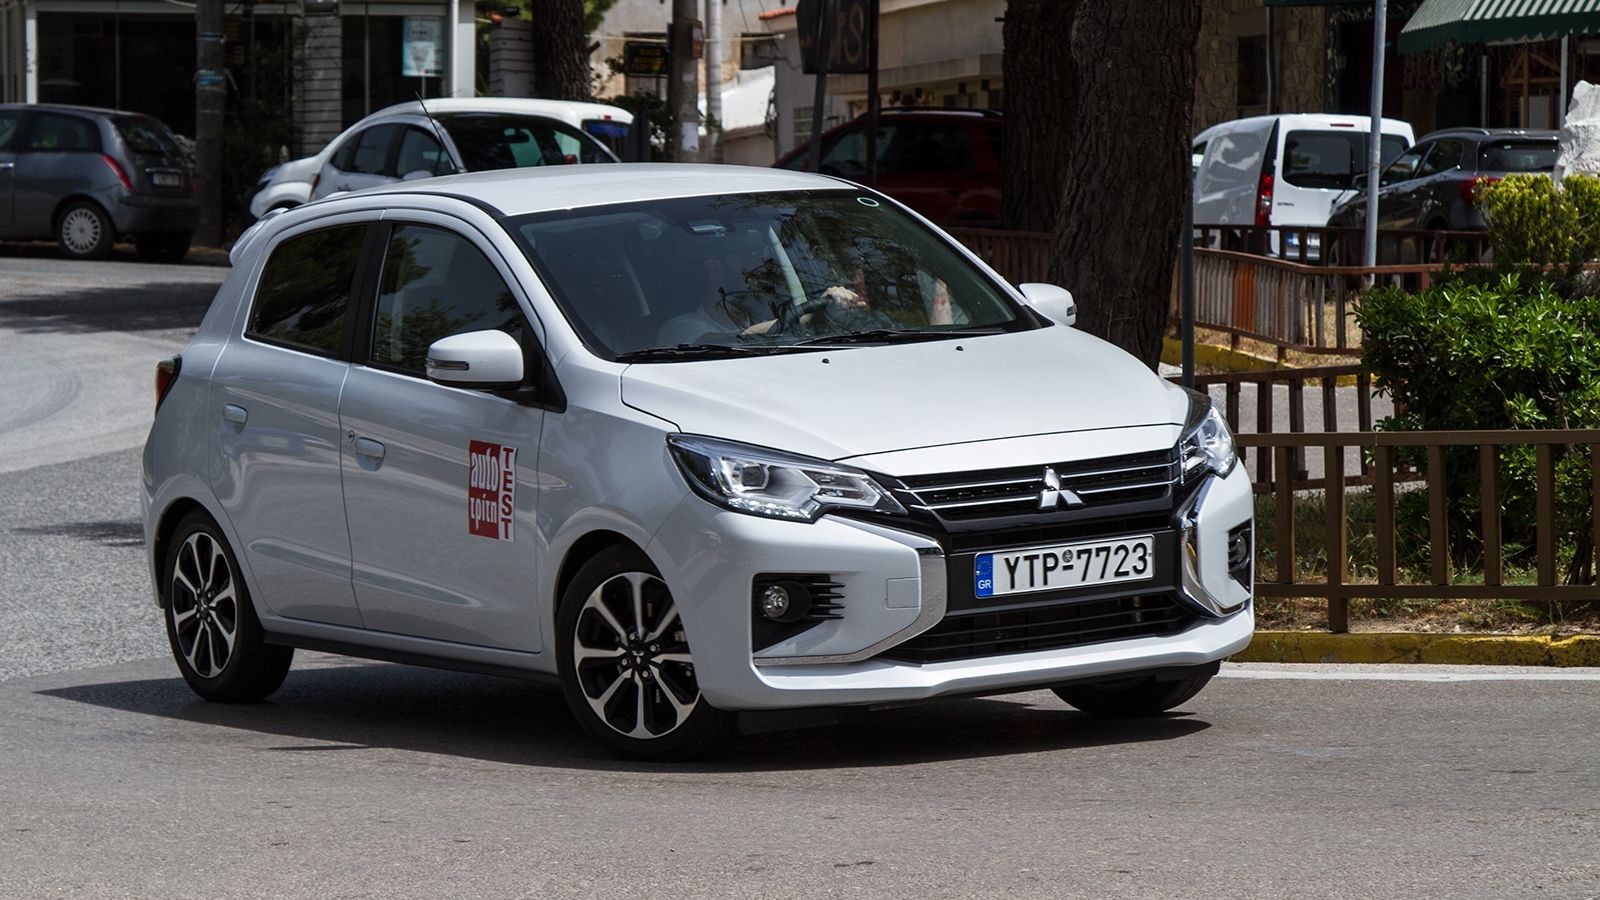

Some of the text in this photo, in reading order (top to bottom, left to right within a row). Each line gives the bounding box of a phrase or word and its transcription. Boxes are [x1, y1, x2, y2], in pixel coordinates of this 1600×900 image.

[471, 447, 499, 492] auto
[470, 493, 498, 530] τρίτη
[501, 447, 514, 540] TEST
[977, 579, 992, 590] GR
